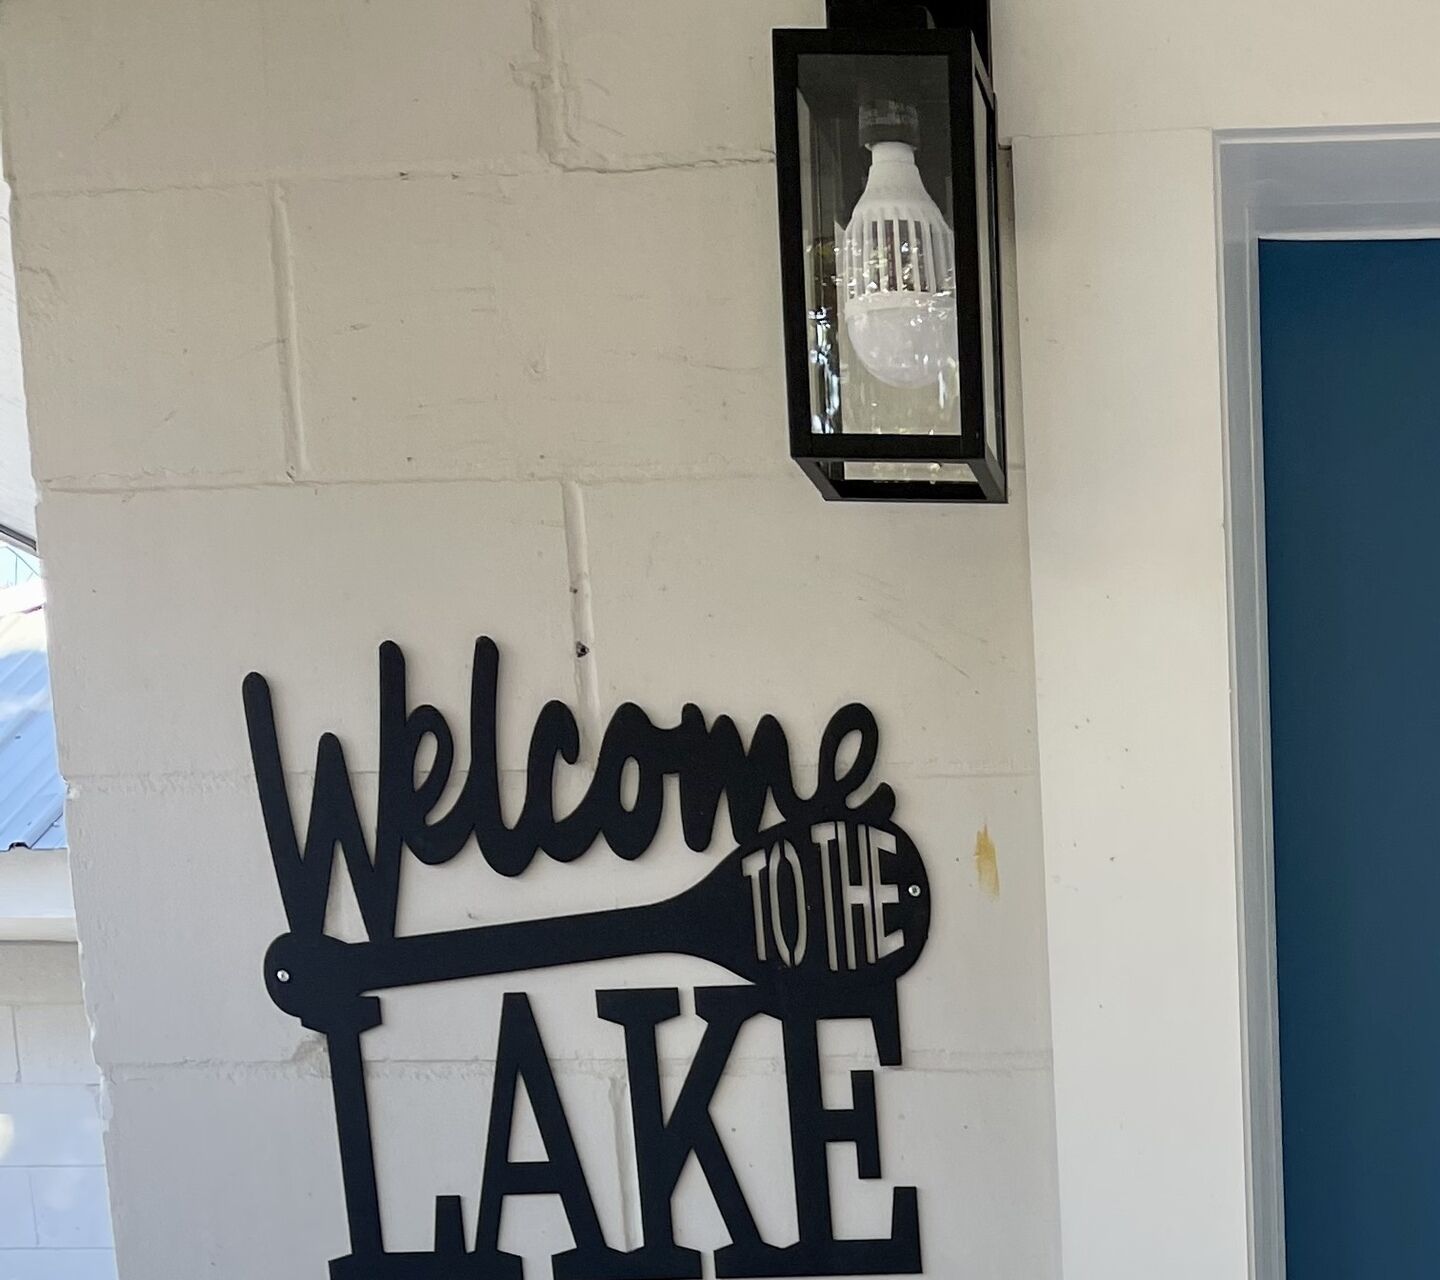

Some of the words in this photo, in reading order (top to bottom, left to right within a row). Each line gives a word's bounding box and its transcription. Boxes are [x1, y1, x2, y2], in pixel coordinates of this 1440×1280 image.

[242, 635, 896, 944] Welcome
[741, 838, 808, 968] TO
[810, 821, 905, 972] THE
